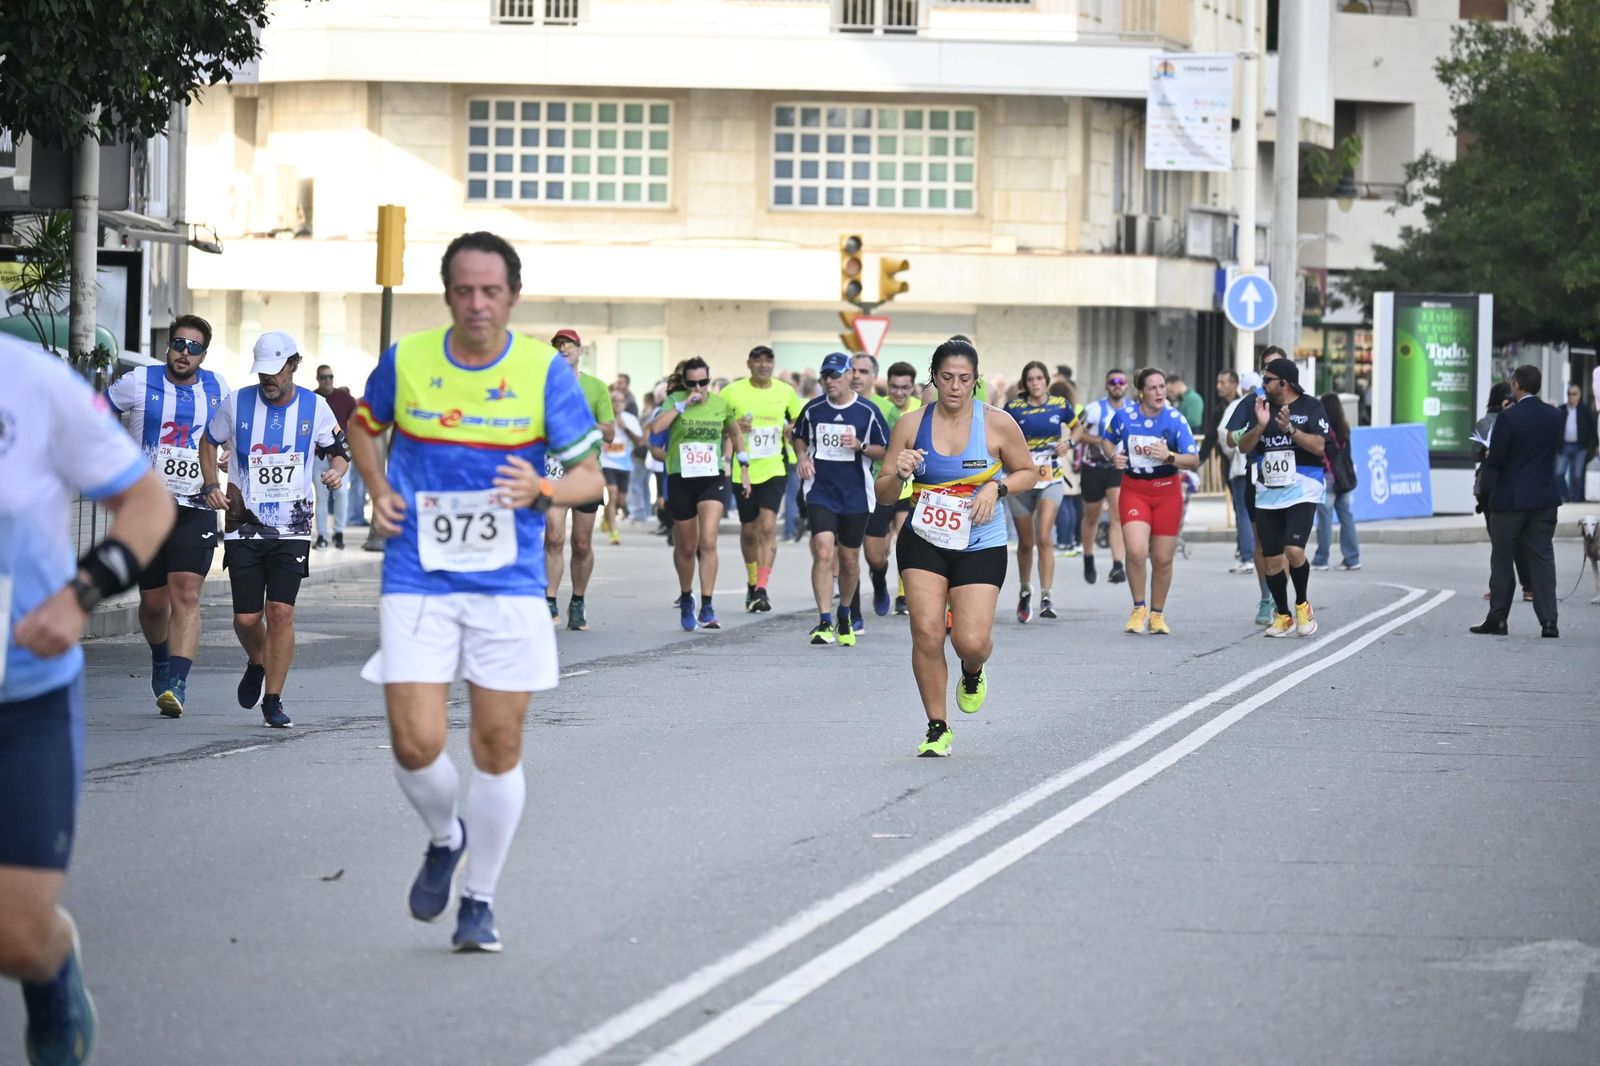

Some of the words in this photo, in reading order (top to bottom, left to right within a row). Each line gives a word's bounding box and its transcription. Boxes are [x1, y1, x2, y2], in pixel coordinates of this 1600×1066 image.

[1425, 342, 1470, 360] Todo.
[160, 421, 202, 450] 21K
[754, 434, 776, 447] 971
[822, 433, 844, 447] 68
[686, 451, 712, 465] 950
[1134, 445, 1151, 456] 96
[163, 459, 200, 479] 888
[258, 465, 296, 485] 887
[545, 464, 565, 480] 949
[1264, 460, 1289, 474] 940
[921, 505, 962, 531] 595
[434, 512, 497, 543] 973
